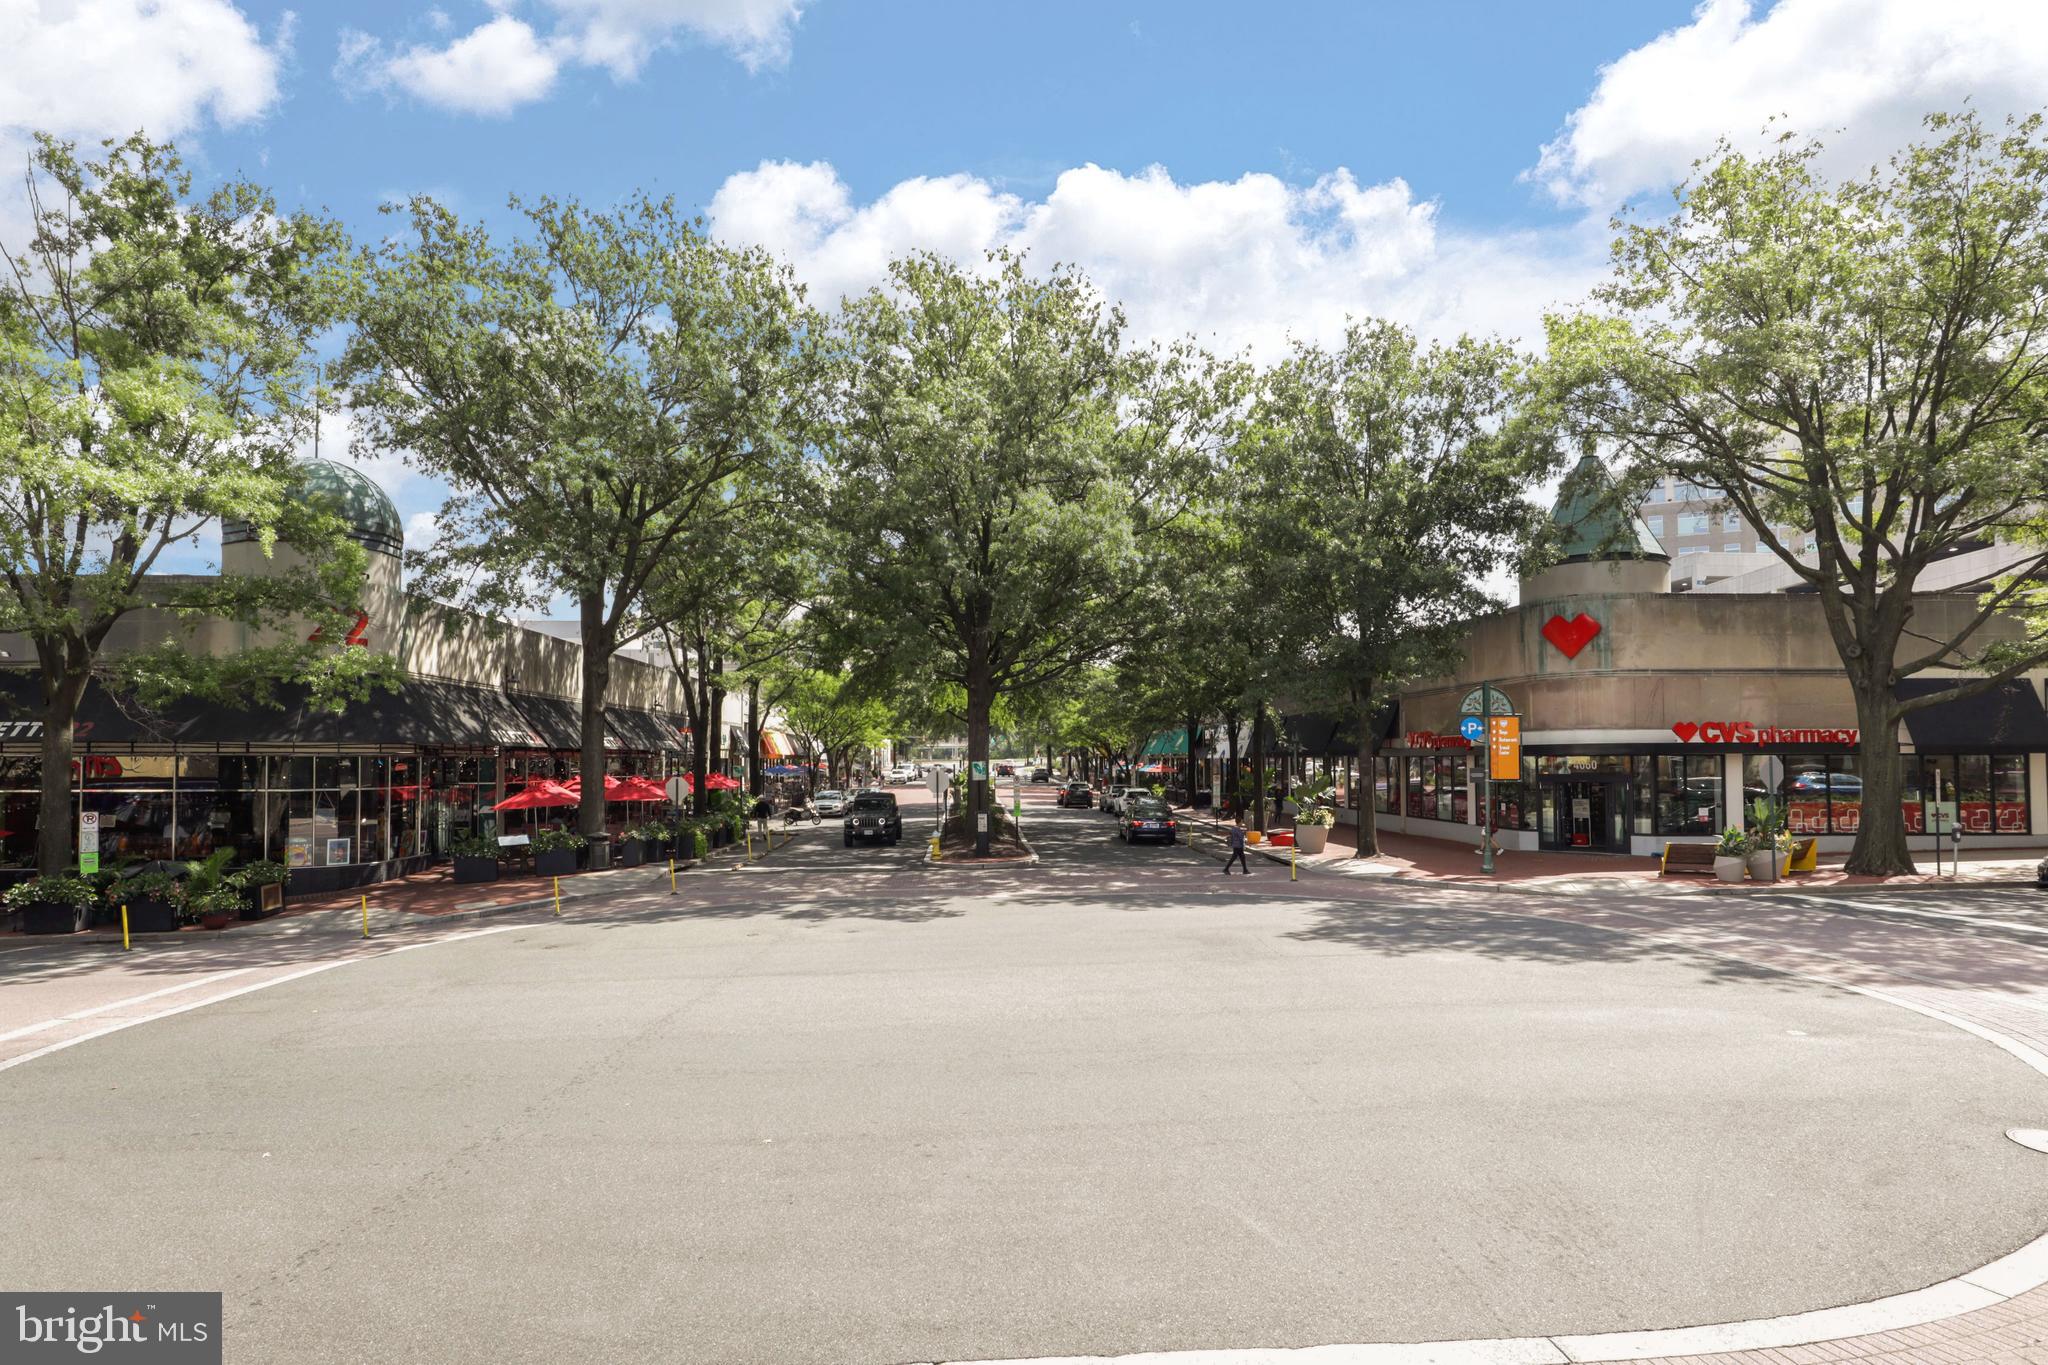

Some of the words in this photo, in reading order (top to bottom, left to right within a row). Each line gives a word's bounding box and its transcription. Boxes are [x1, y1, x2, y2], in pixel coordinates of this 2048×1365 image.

[1468, 723, 1477, 734] P
[1699, 721, 1755, 743] CVS
[1757, 725, 1857, 747] pharmacy
